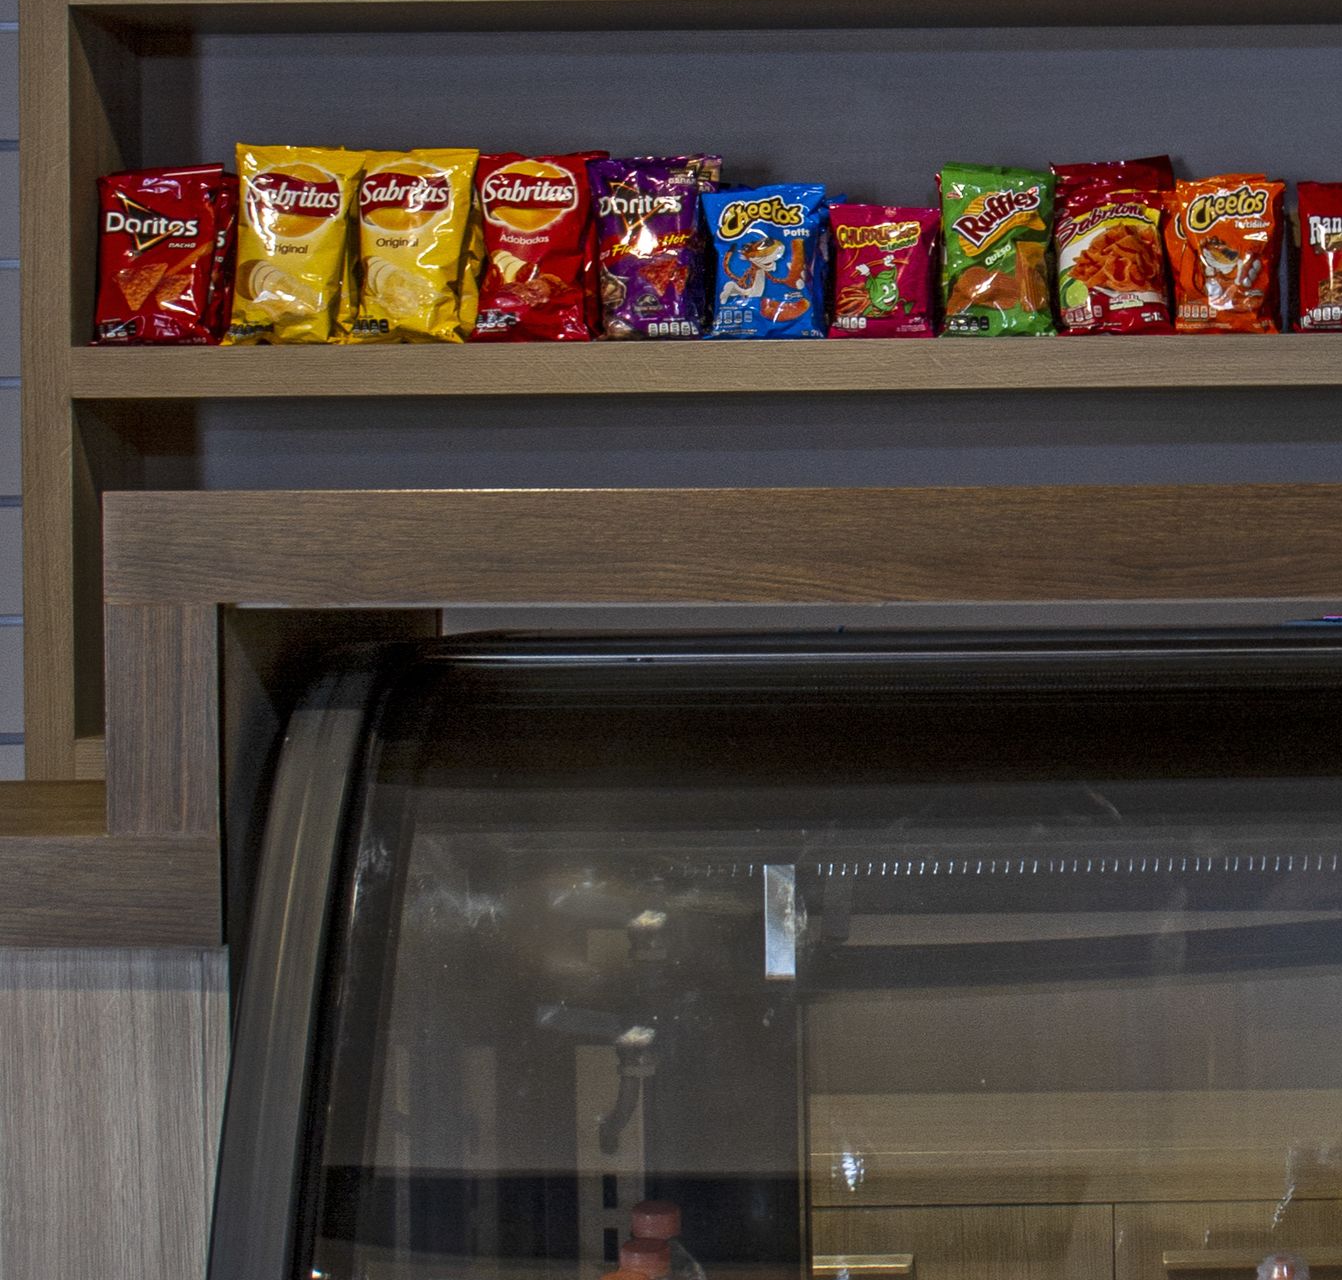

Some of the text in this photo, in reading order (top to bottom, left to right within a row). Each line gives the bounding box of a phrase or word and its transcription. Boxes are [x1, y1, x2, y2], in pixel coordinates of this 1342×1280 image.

[244, 179, 341, 209] Sabritas
[360, 180, 450, 206] Sabritas
[482, 179, 575, 203] Sabritas
[598, 195, 682, 217] Doritos
[720, 200, 802, 238] Cheetos
[954, 187, 1040, 246] Ruffles
[1189, 189, 1266, 230] Cheetos
[105, 211, 198, 237] Doritos
[1057, 204, 1154, 248] Sabriton
[375, 237, 419, 249] Original
[500, 234, 550, 246] Adobadas
[984, 243, 1013, 266] QUESO
